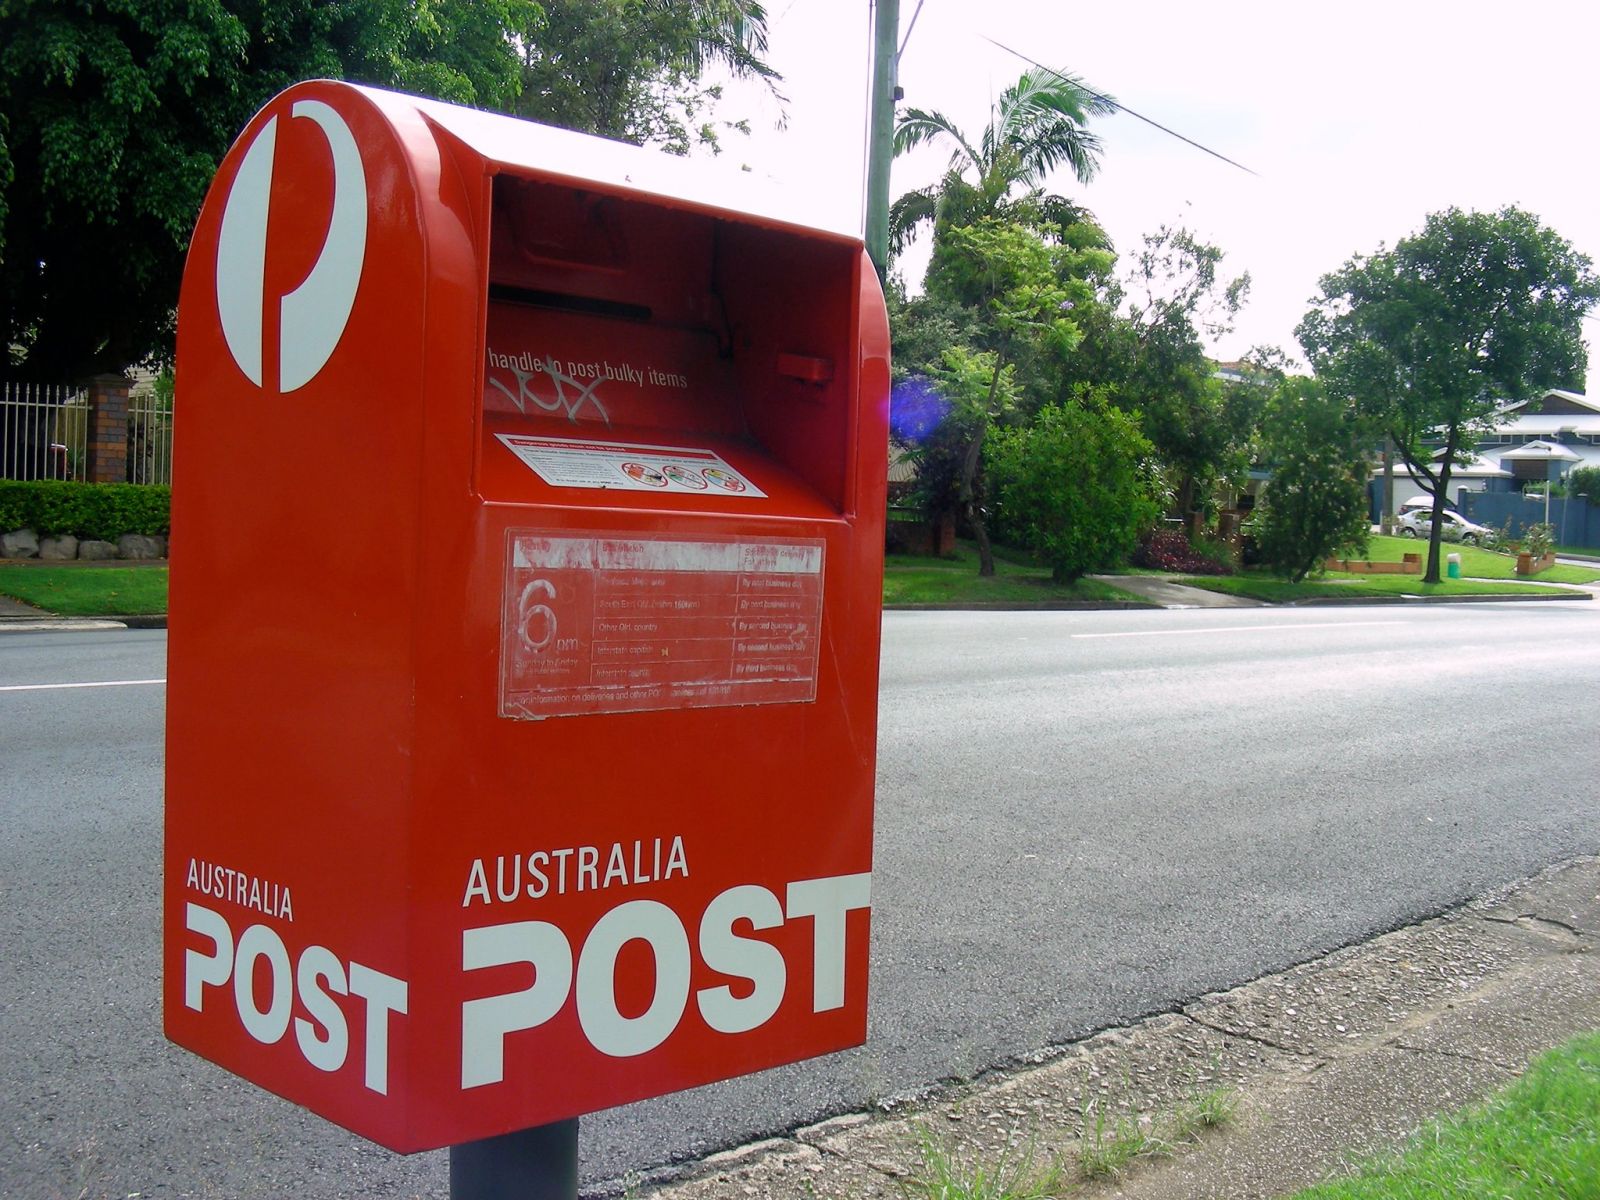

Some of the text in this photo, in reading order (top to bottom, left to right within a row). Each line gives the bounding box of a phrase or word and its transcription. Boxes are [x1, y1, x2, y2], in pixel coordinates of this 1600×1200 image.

[488, 347, 542, 372] handle
[568, 361, 600, 378] post
[604, 361, 643, 387] bulky
[648, 366, 688, 388] items
[518, 579, 557, 653] 6
[572, 695, 582, 703] on
[615, 690, 629, 700] and
[187, 858, 294, 923] AUSTRALIA
[463, 836, 690, 908] AUSTRALIA
[185, 902, 408, 1096] POST
[461, 872, 871, 1090] POST
